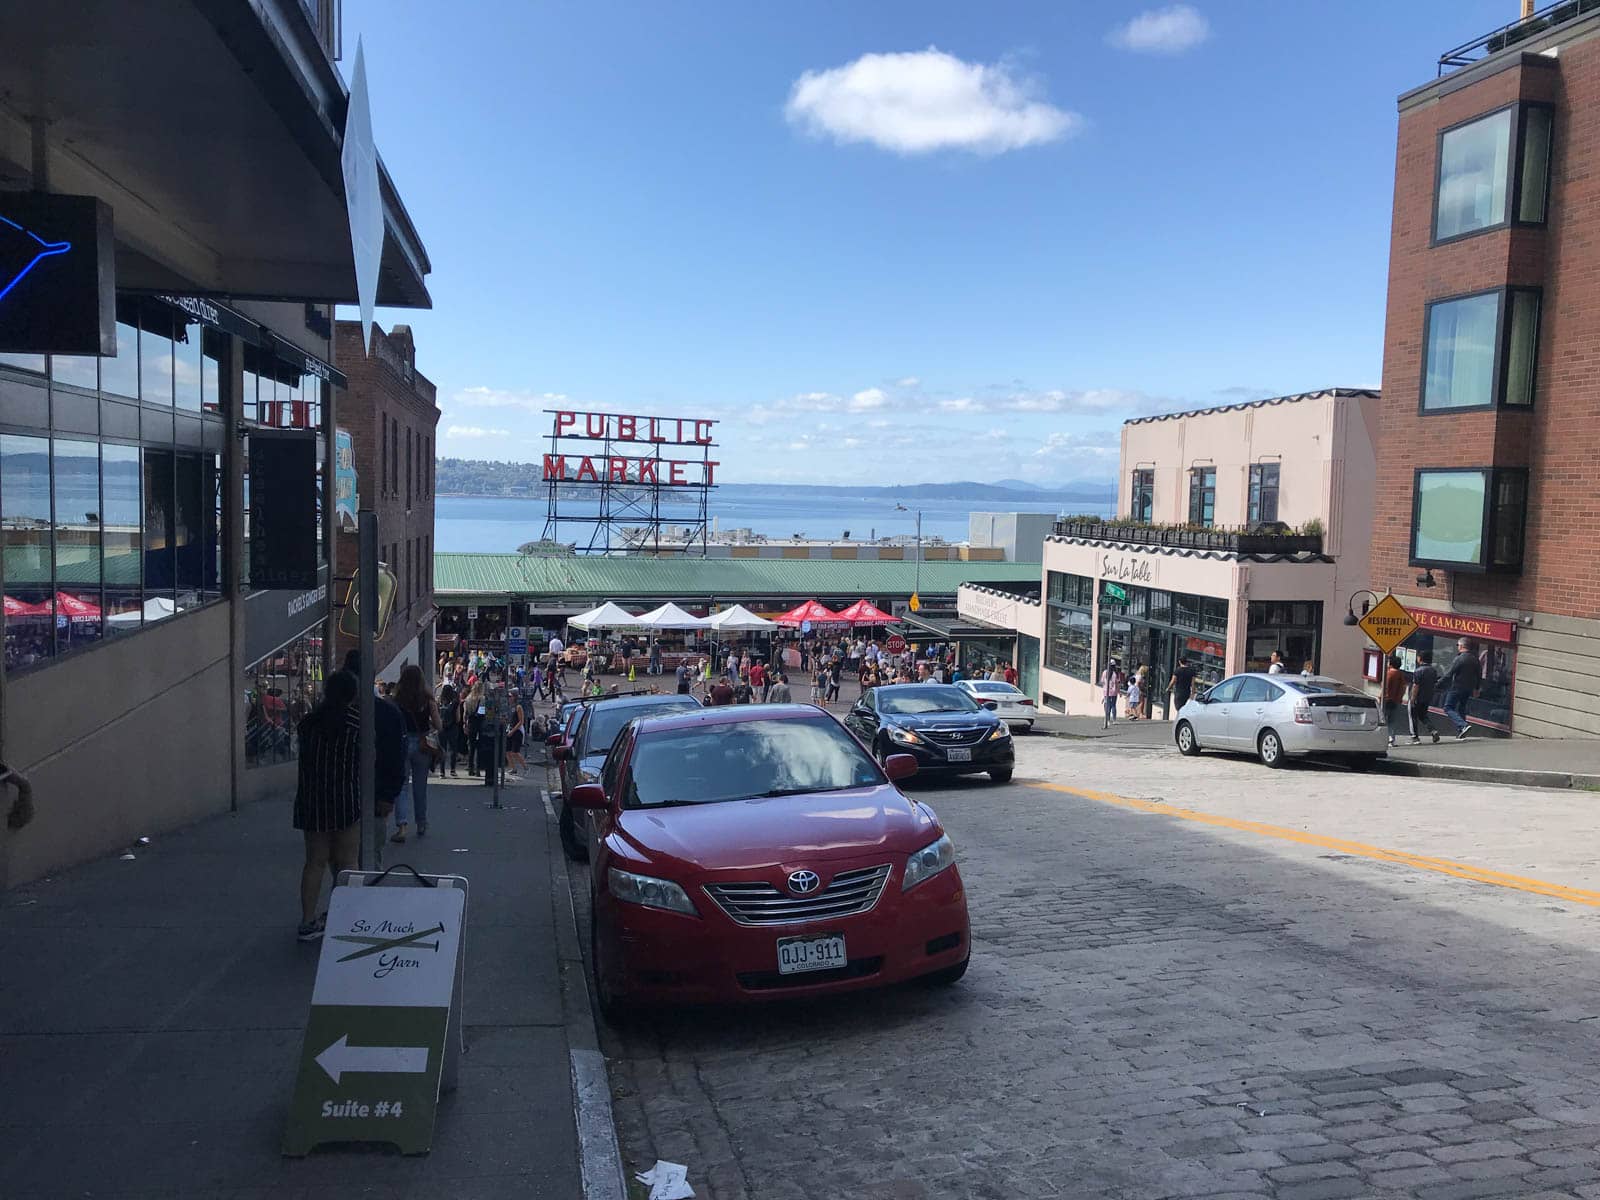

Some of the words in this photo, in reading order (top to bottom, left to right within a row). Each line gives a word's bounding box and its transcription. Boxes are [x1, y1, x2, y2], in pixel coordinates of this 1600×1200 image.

[556, 410, 713, 444] PUBLIC
[543, 453, 721, 487] MARKET
[1101, 554, 1118, 578] Sur
[1118, 557, 1130, 580] La
[1130, 558, 1152, 582] Table
[1367, 616, 1410, 626] RESIDENTIAL
[1430, 615, 1491, 635] CAMPAGNE
[1376, 627, 1401, 636] STREET
[887, 640, 905, 649] STOP
[350, 919, 371, 933] So
[373, 920, 415, 934] Much
[373, 954, 421, 979] Yarn
[321, 1099, 370, 1118] Suite
[374, 1100, 403, 1118] #4
